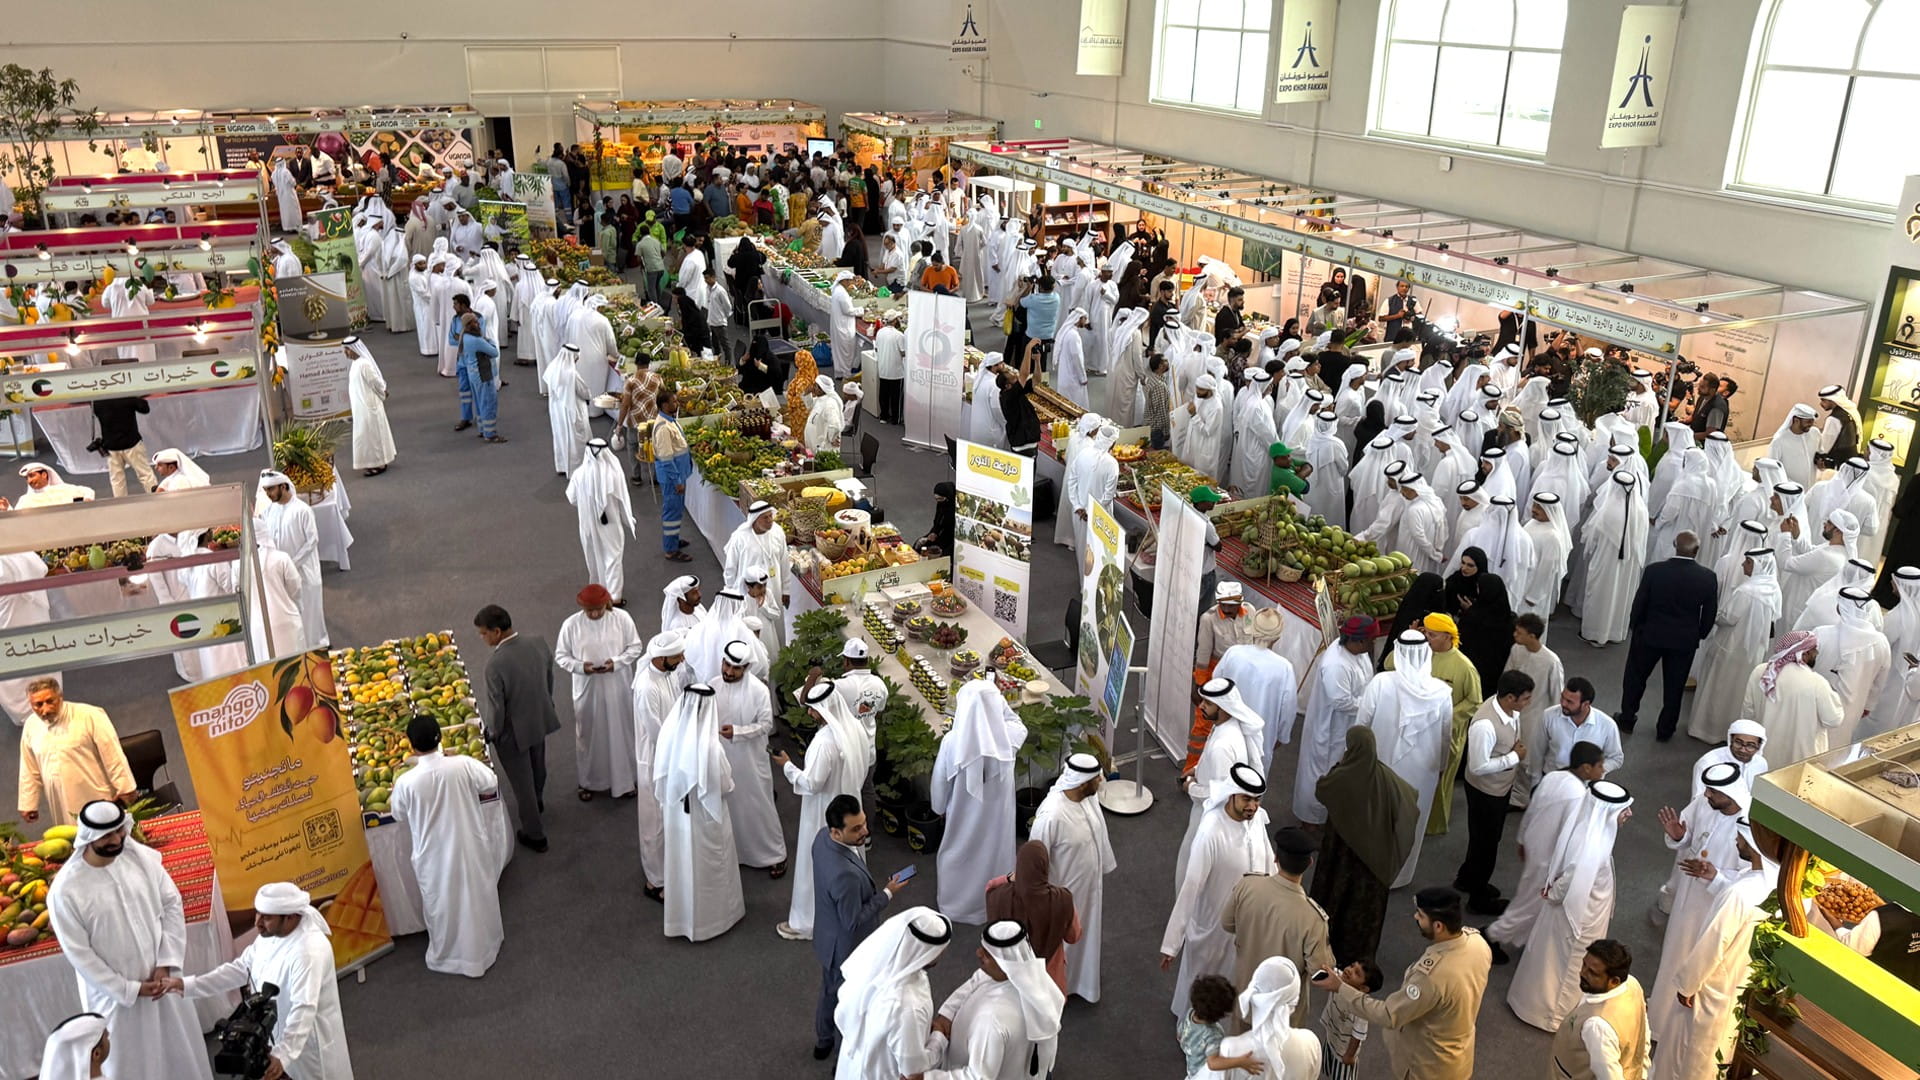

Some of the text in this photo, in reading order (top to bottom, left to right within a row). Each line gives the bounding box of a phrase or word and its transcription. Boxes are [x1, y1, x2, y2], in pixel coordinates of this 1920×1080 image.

[1279, 83, 1328, 92] EXPO KHOR FAKKAN
[34, 261, 68, 276] قطر
[67, 366, 198, 391] خيرات الكويت
[970, 454, 1019, 476] مزرعة النور
[5, 622, 152, 658] خيرات سلطنة
[192, 697, 254, 725] mango
[211, 714, 244, 736] nito
